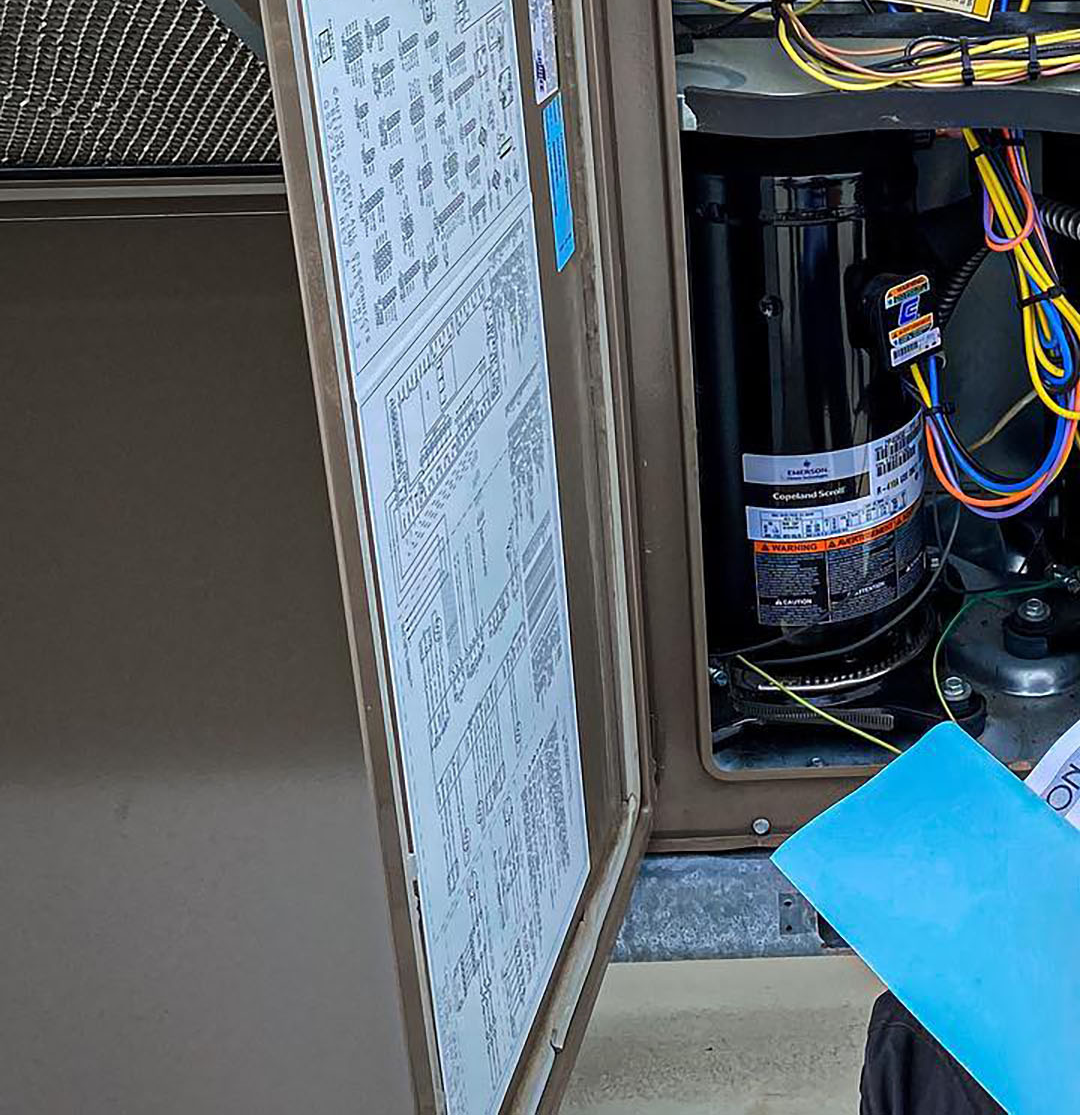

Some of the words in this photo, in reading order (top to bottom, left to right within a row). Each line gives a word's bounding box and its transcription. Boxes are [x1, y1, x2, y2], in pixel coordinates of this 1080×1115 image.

[787, 467, 828, 477] EMERSON
[772, 492, 817, 502] Copeland
[819, 486, 847, 499] Scroll
[772, 543, 818, 552] WARNING
